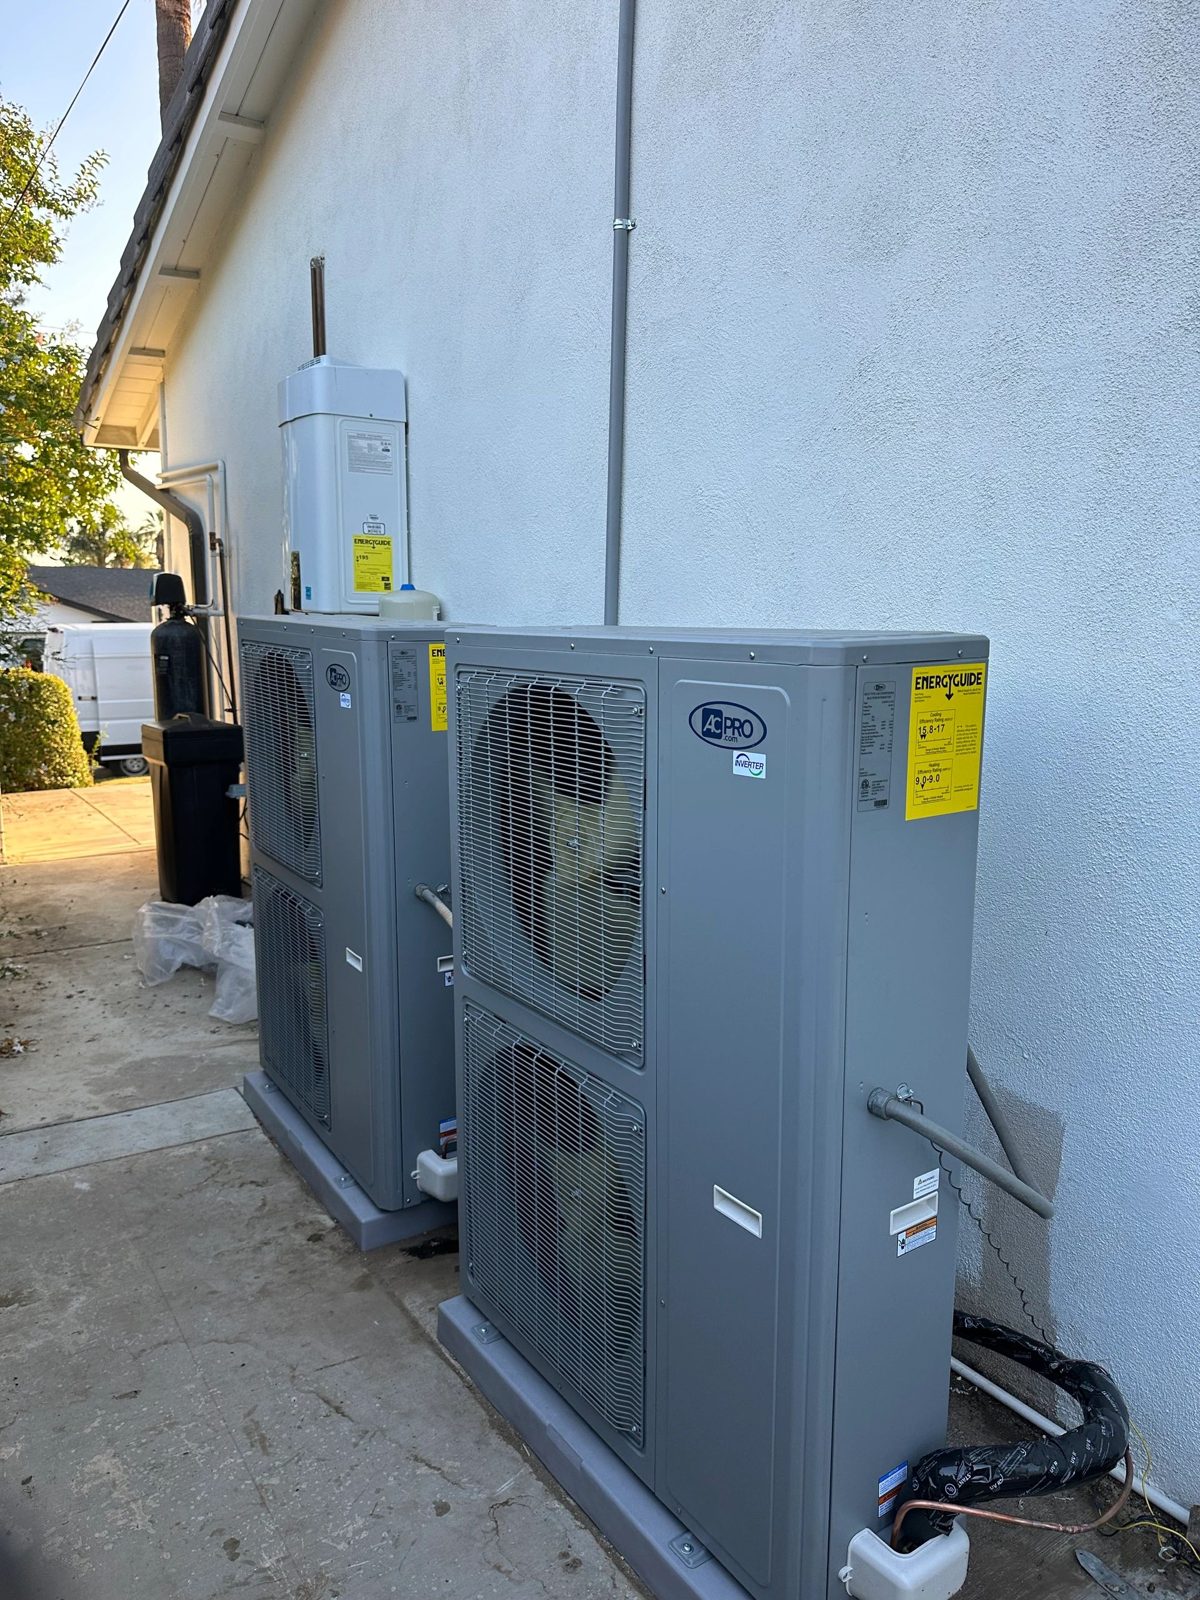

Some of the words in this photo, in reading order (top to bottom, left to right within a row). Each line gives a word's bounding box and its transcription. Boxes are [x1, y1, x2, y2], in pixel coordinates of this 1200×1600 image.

[354, 538, 391, 546] ENERGYGUIDE
[914, 672, 983, 691] ENERGYGUIDE
[918, 723, 945, 735] 15.8-17
[735, 760, 764, 770] INVERTER
[915, 774, 940, 785] 9.0-9.0
